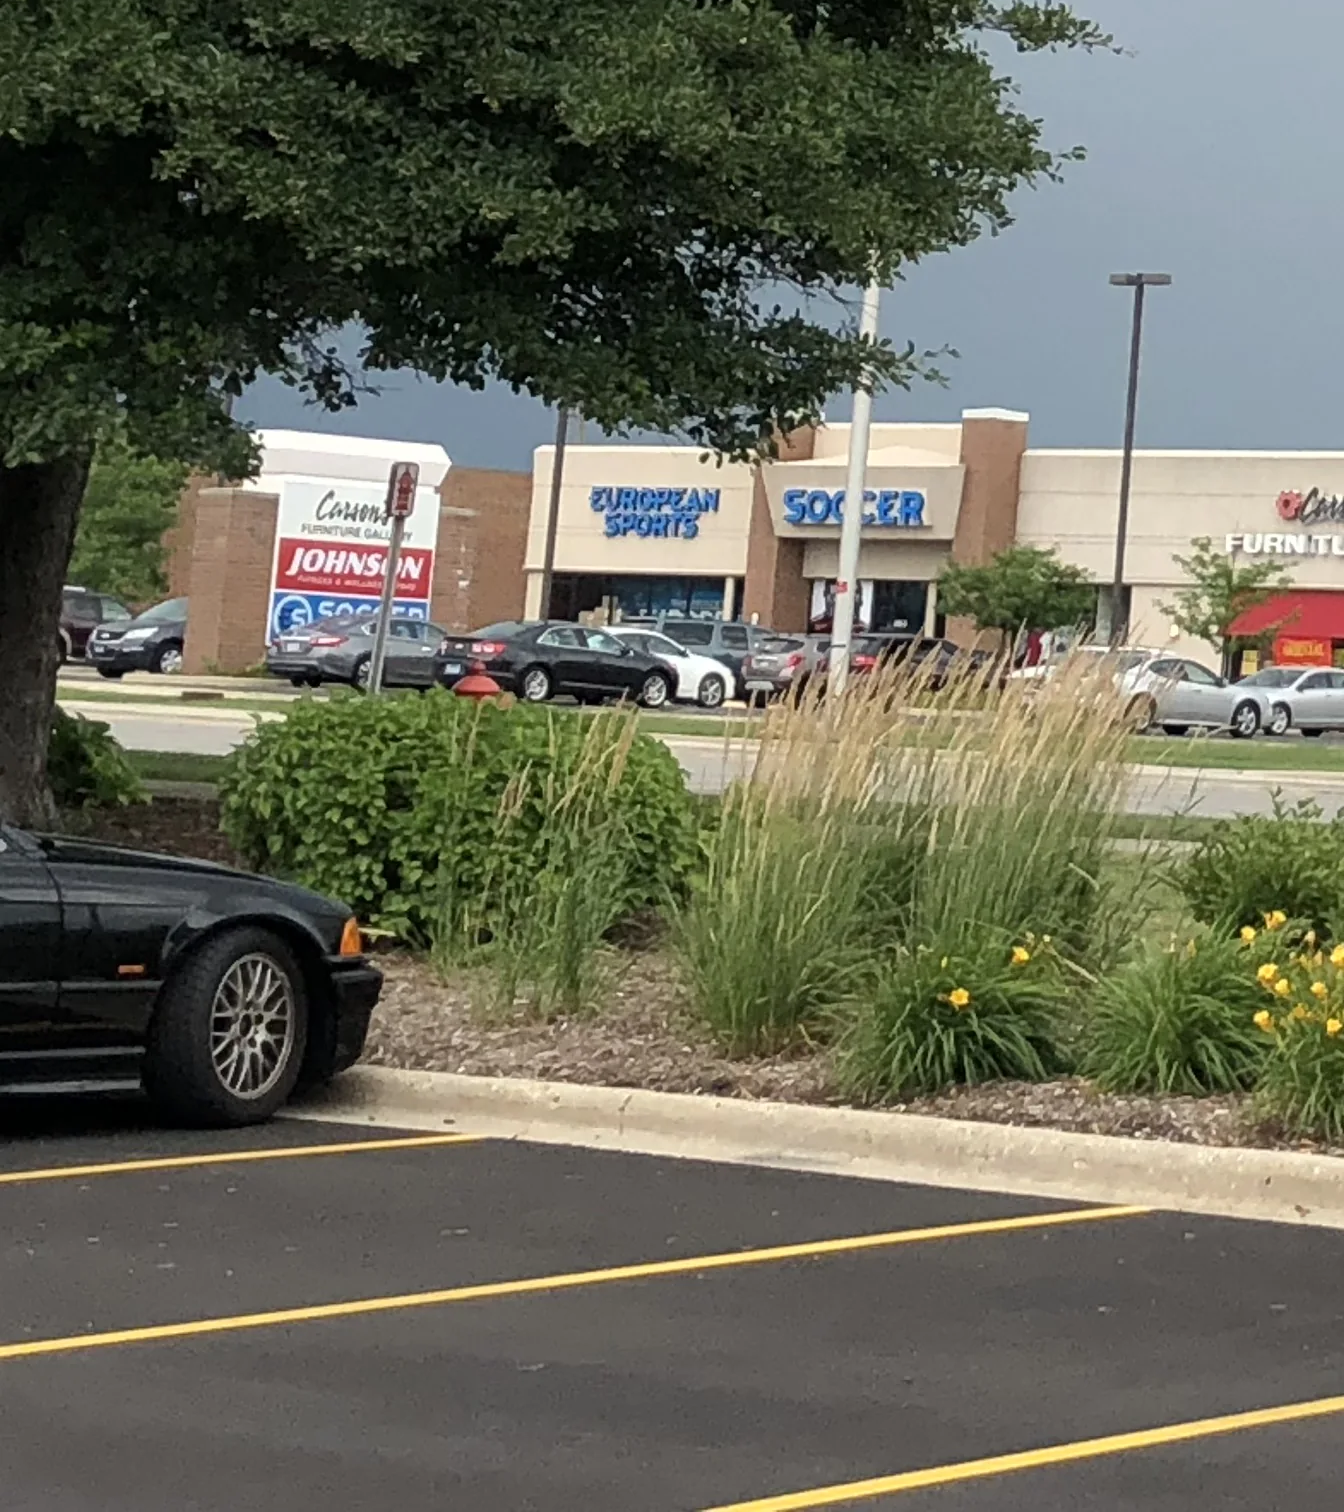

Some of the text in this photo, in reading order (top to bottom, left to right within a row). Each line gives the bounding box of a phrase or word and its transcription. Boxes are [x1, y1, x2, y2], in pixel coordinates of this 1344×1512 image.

[590, 486, 721, 513] EUROPEAN
[783, 488, 926, 526] SOCCER
[604, 511, 702, 539] SPORTS
